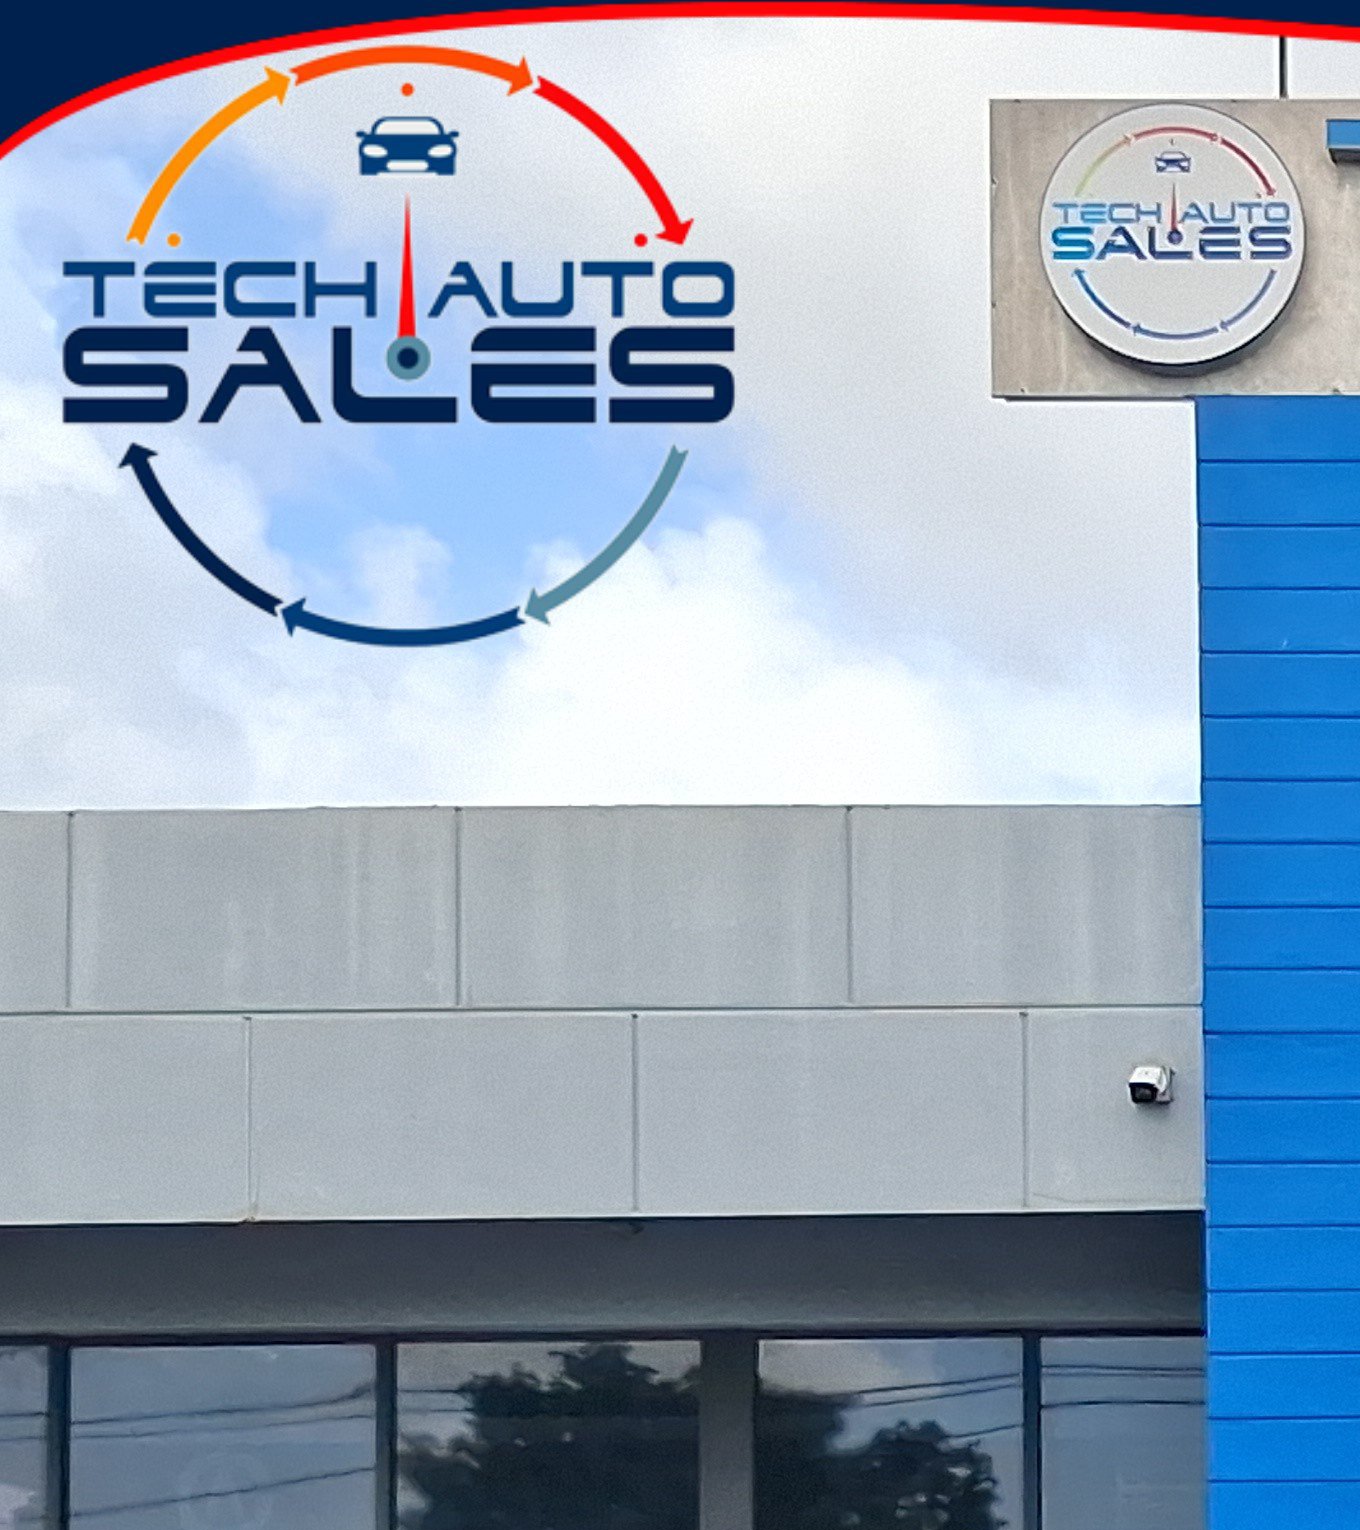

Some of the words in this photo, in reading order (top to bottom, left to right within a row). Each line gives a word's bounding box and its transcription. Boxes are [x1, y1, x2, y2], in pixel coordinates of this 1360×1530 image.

[1052, 202, 1161, 225] TECH
[1182, 202, 1291, 225] AUTO
[1051, 226, 1293, 261] SALES
